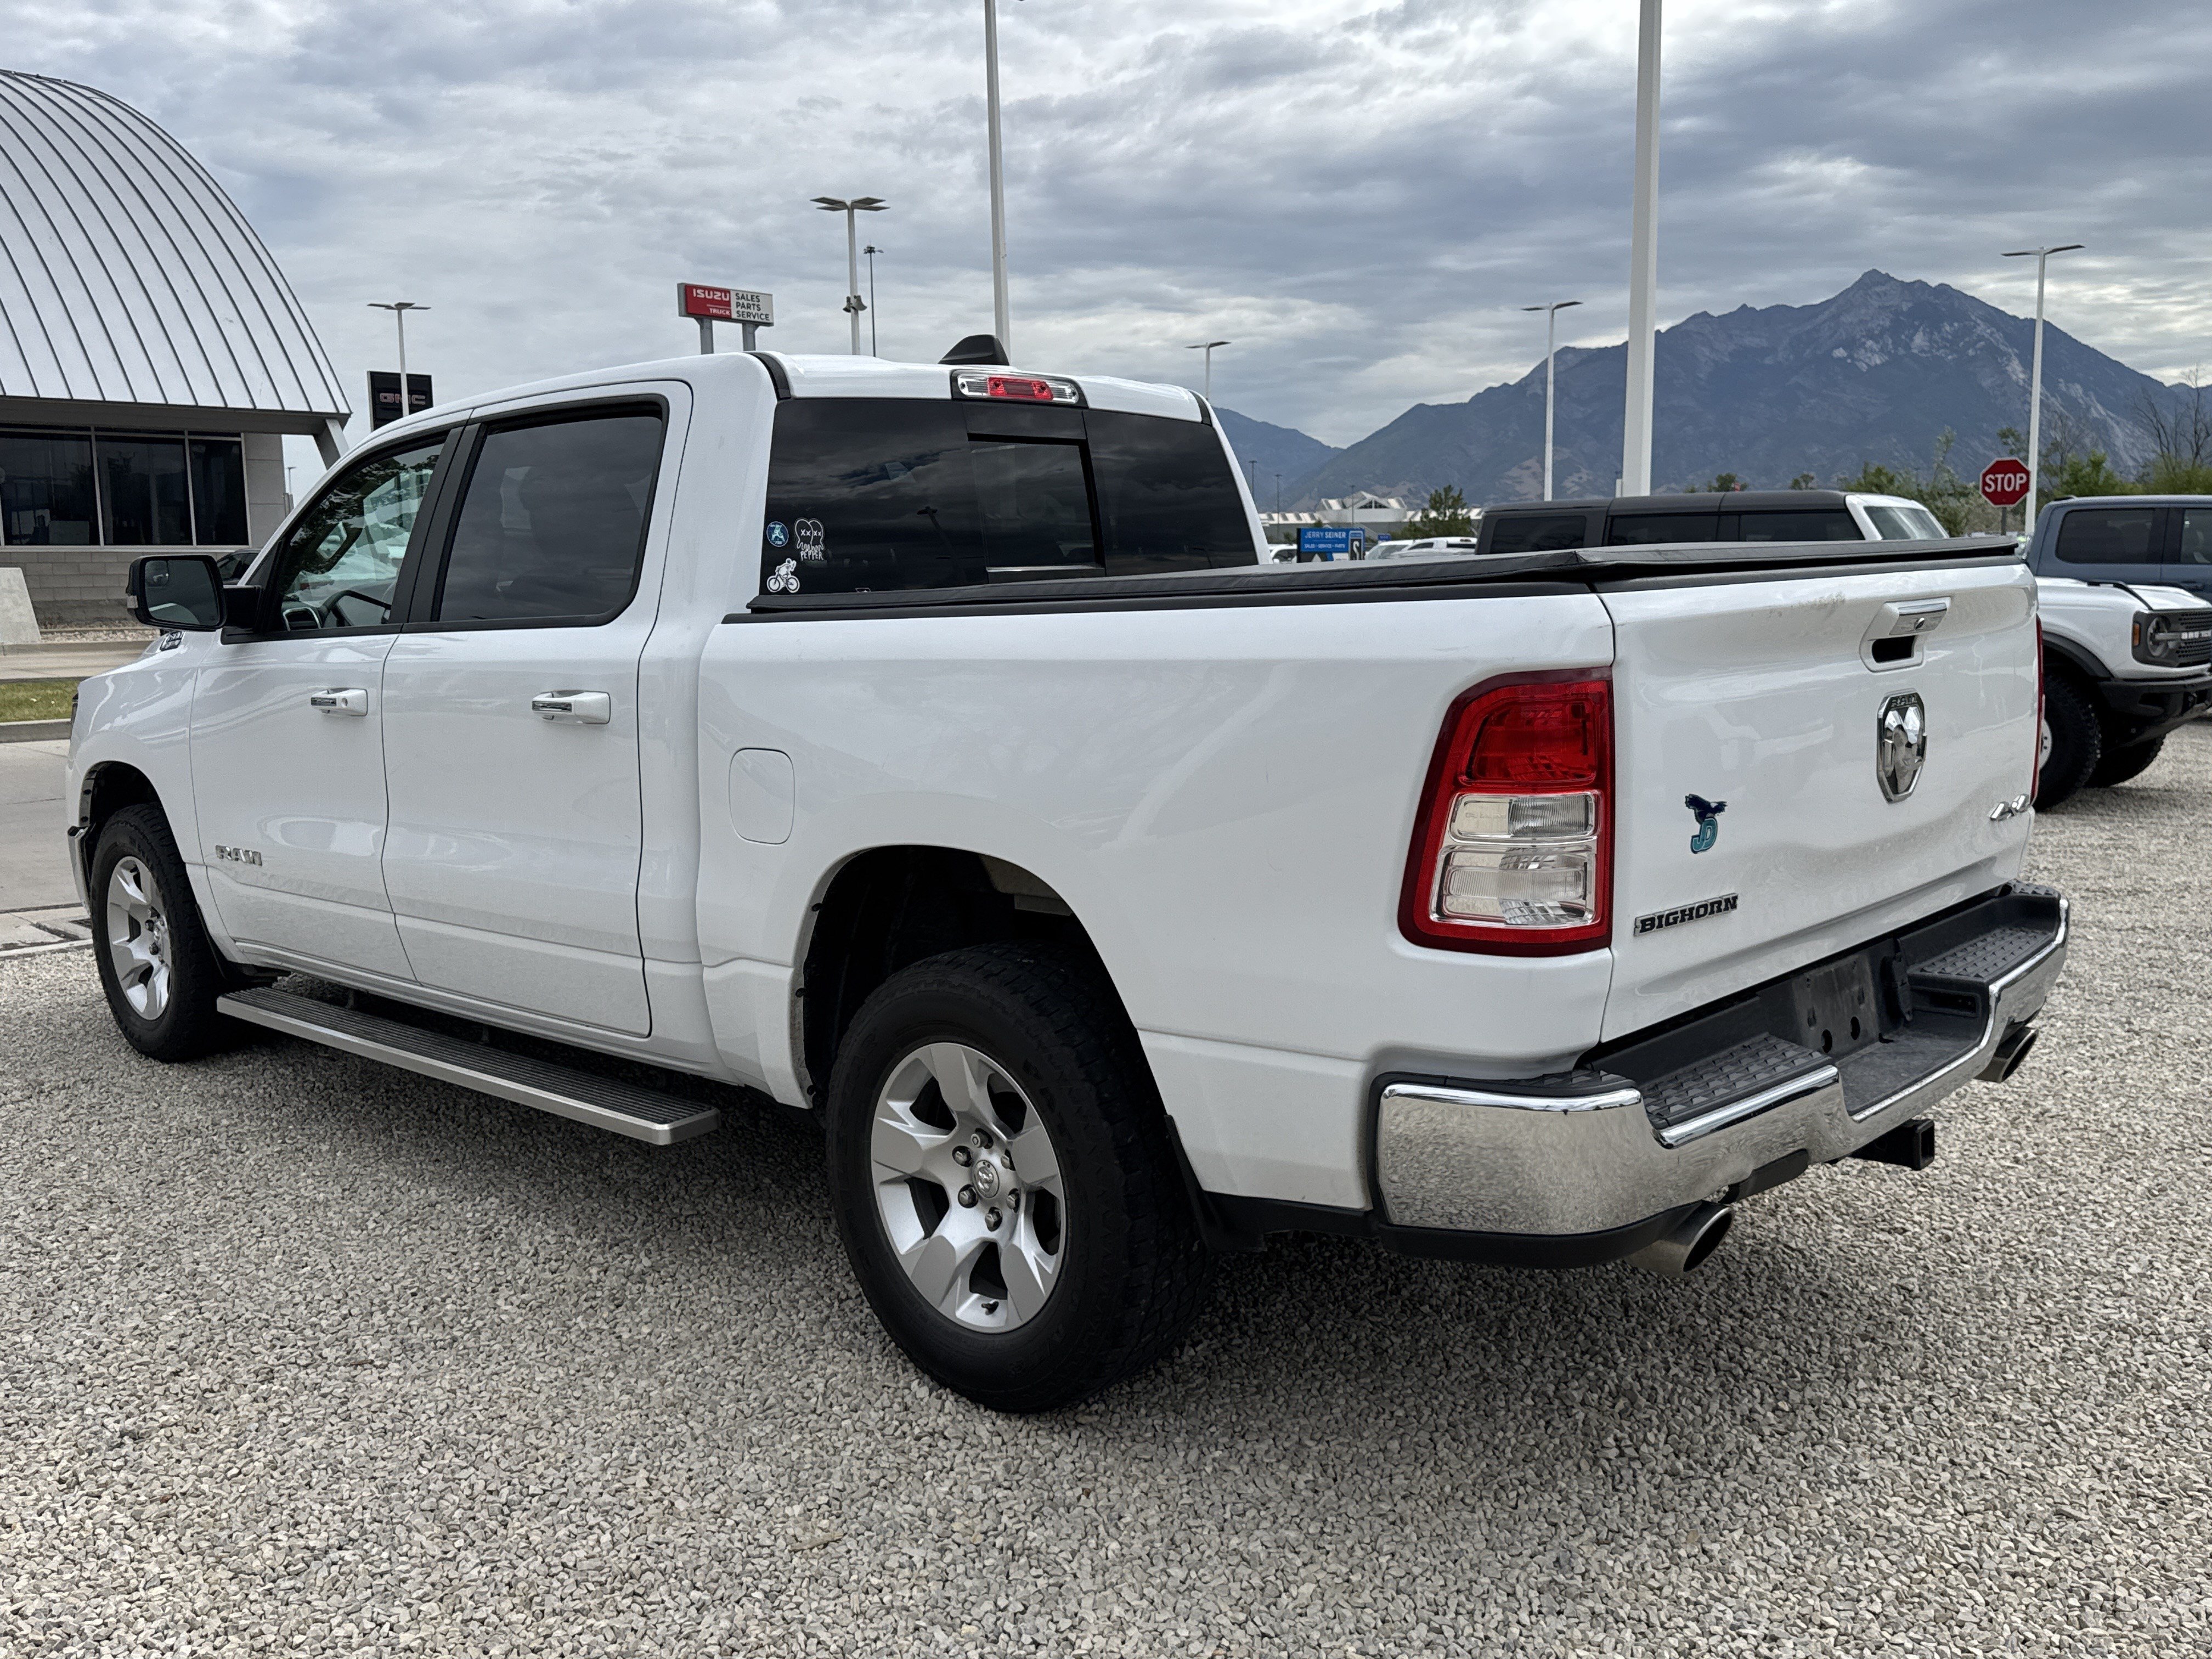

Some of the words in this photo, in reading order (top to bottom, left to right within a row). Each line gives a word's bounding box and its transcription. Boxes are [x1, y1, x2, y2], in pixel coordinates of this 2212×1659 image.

[693, 289, 730, 301] ISUZU
[735, 292, 760, 302] SALES
[736, 302, 761, 311] PARTS
[736, 311, 770, 321] SERVICE
[1984, 472, 2027, 493] STOP
[800, 550, 824, 561] PEPPER
[215, 845, 262, 867] RAM
[1638, 894, 1739, 934] BIGHORN
